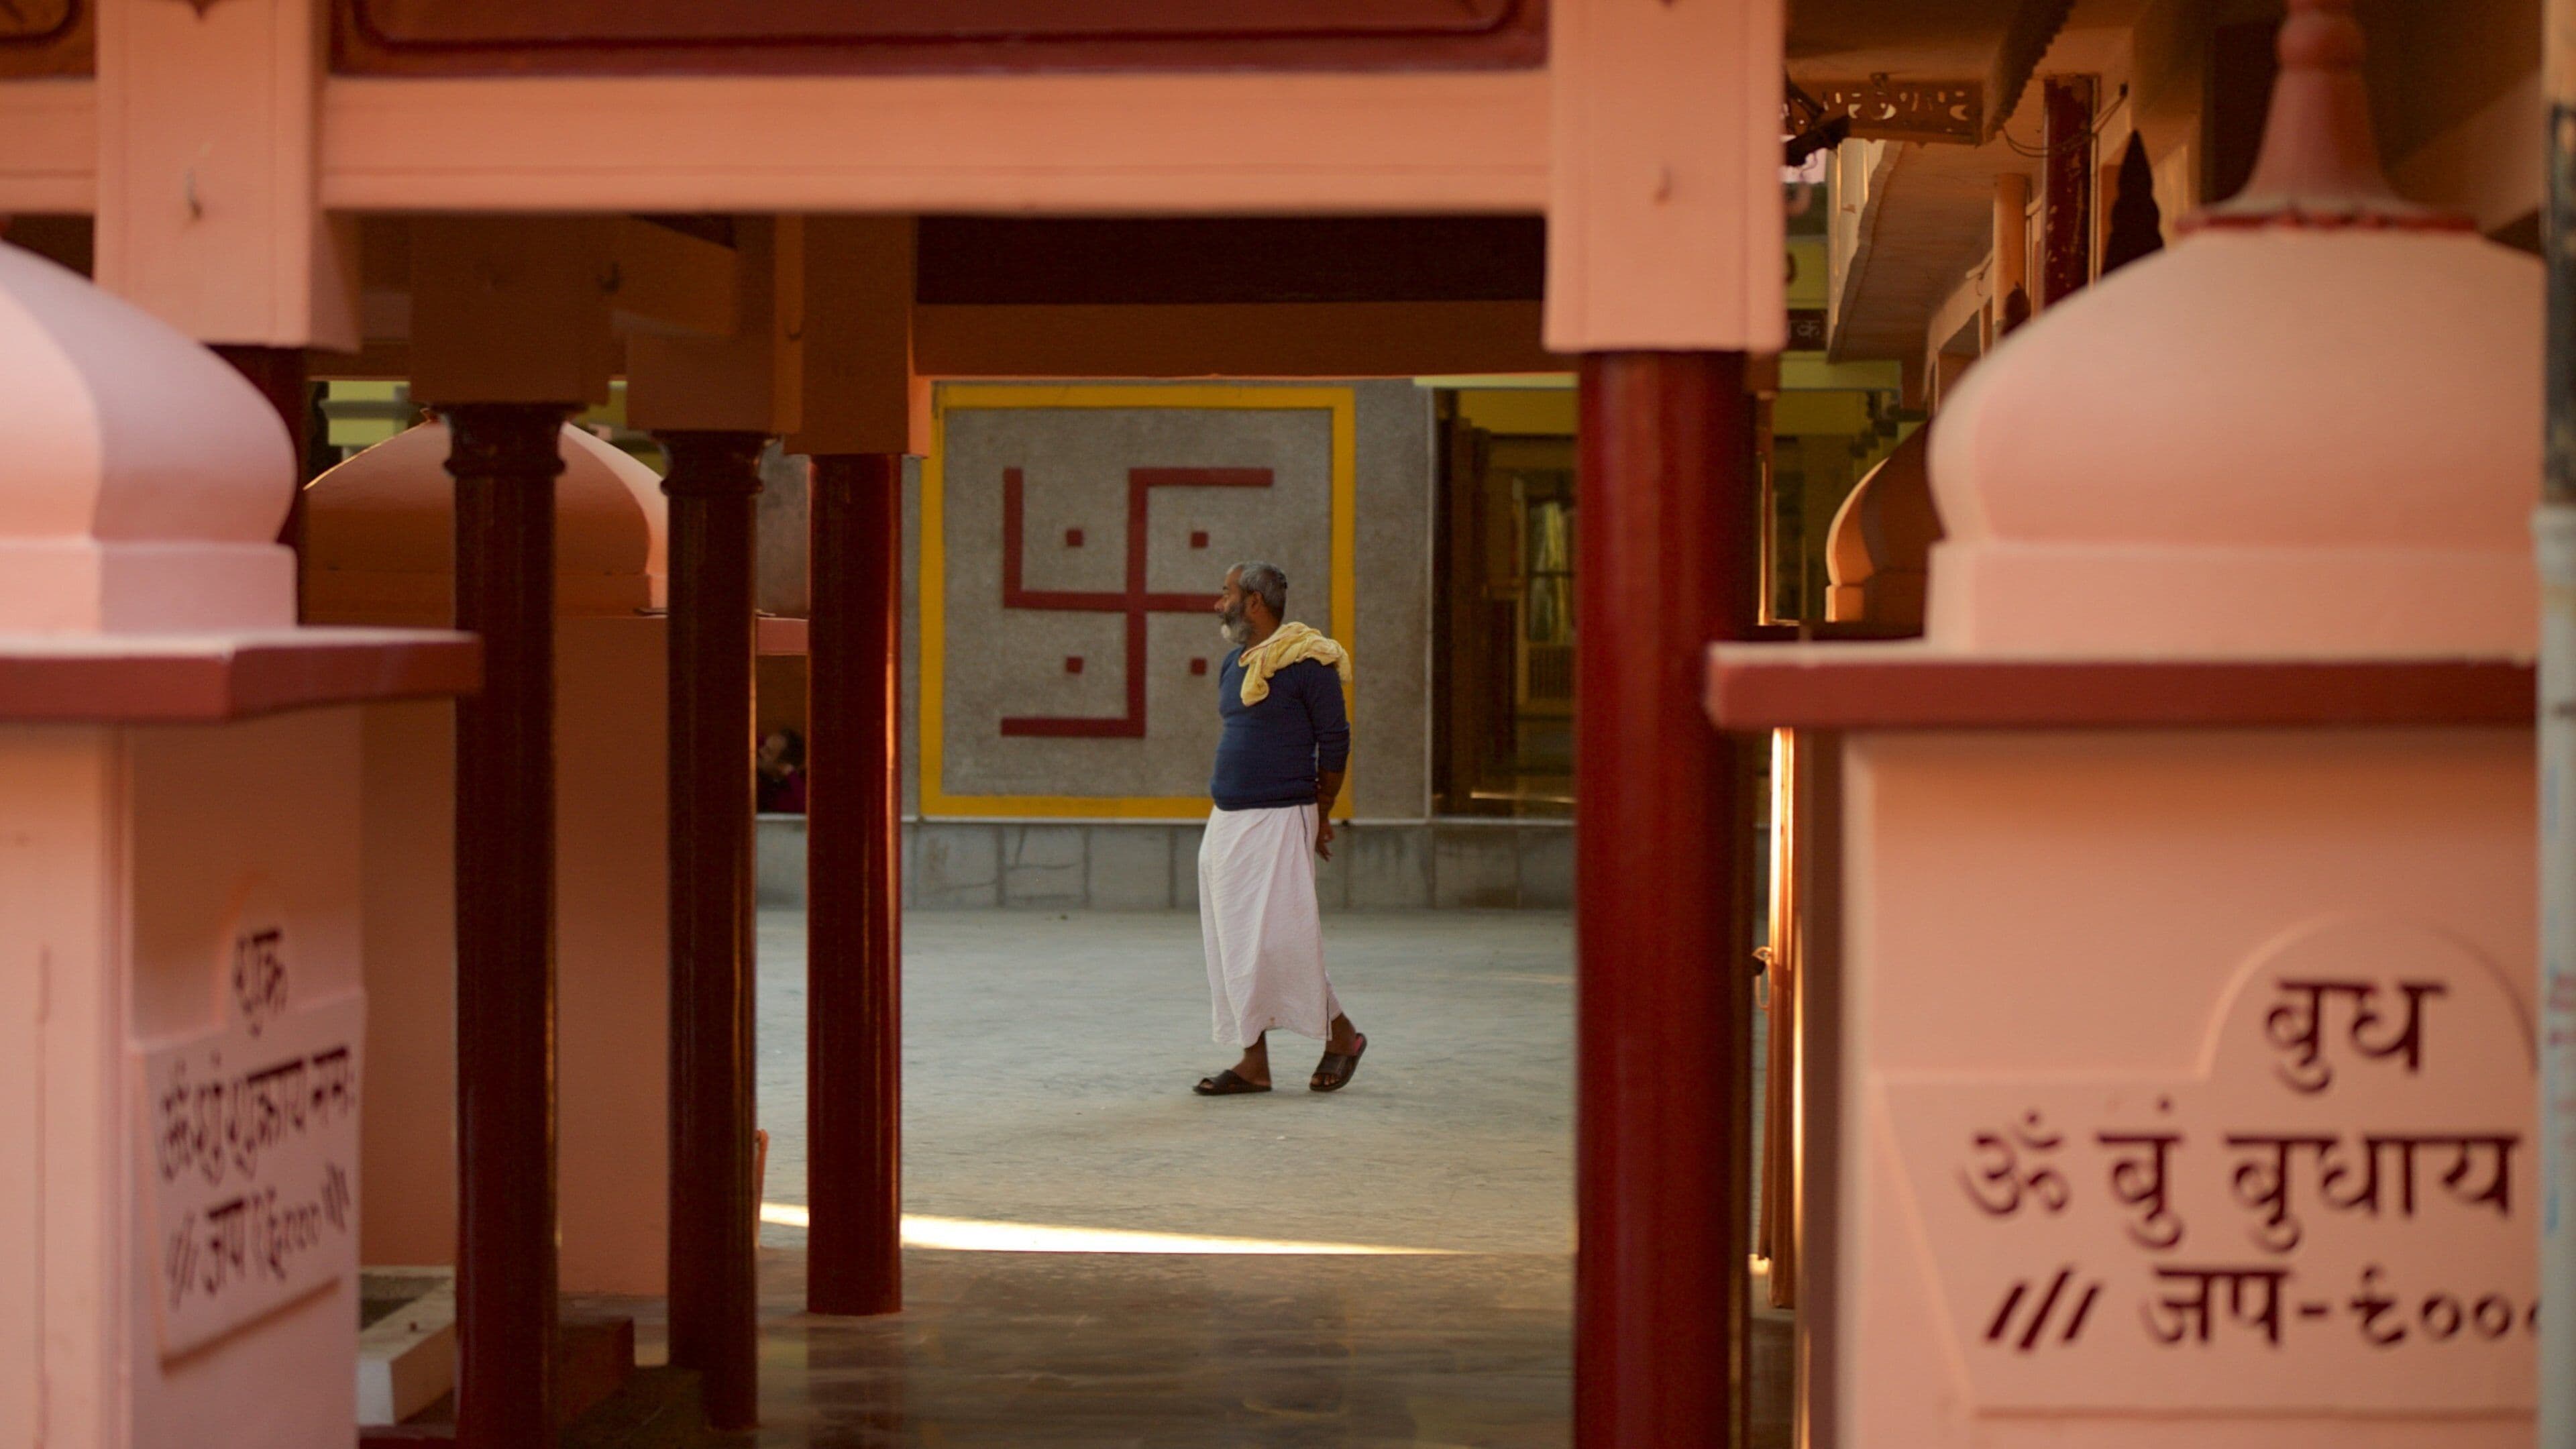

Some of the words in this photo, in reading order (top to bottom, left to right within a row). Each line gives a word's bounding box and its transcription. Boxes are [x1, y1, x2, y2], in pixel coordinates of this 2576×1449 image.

[2265, 978, 2447, 1095] बुध
[1958, 1107, 2070, 1216] ॐ
[2094, 1095, 2186, 1250] बुं
[2224, 1133, 2524, 1253] बुधाय
